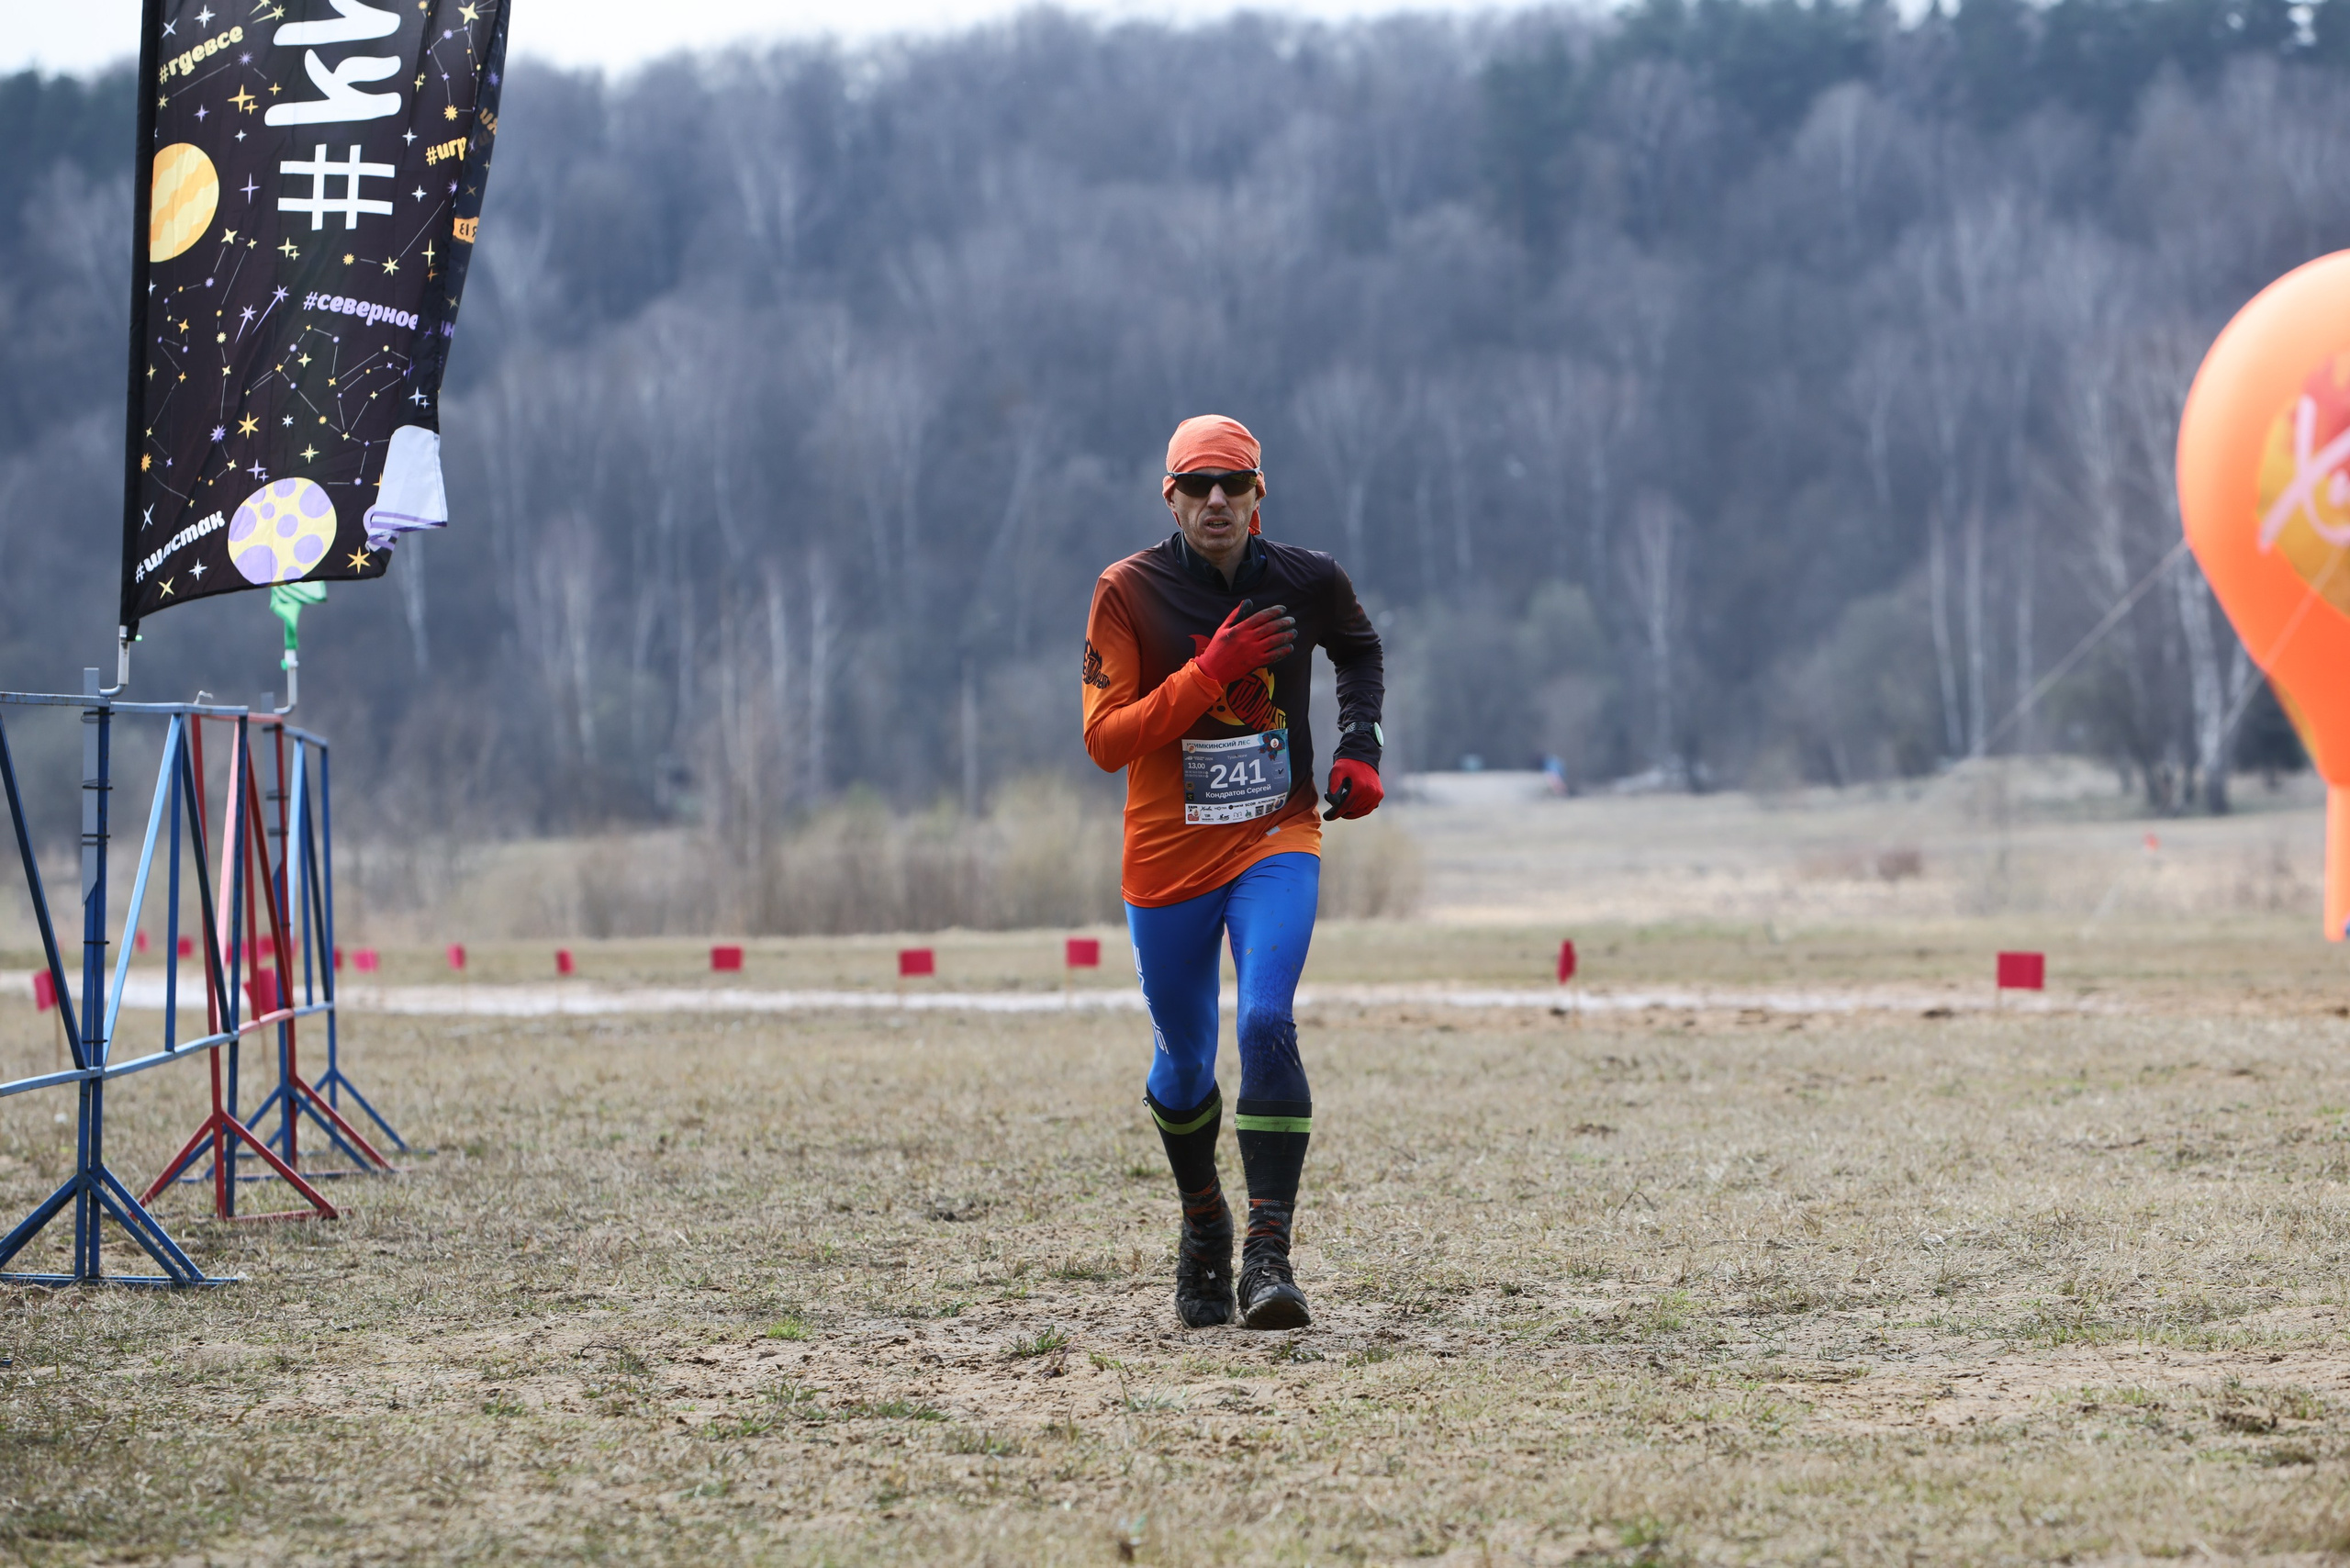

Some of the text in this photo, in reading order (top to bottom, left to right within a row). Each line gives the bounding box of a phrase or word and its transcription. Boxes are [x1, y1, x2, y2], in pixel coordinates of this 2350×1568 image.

[159, 26, 243, 84] #гдевсе
[1210, 758, 1267, 790] 241
[1205, 784, 1271, 799] Кондратов Сергей
